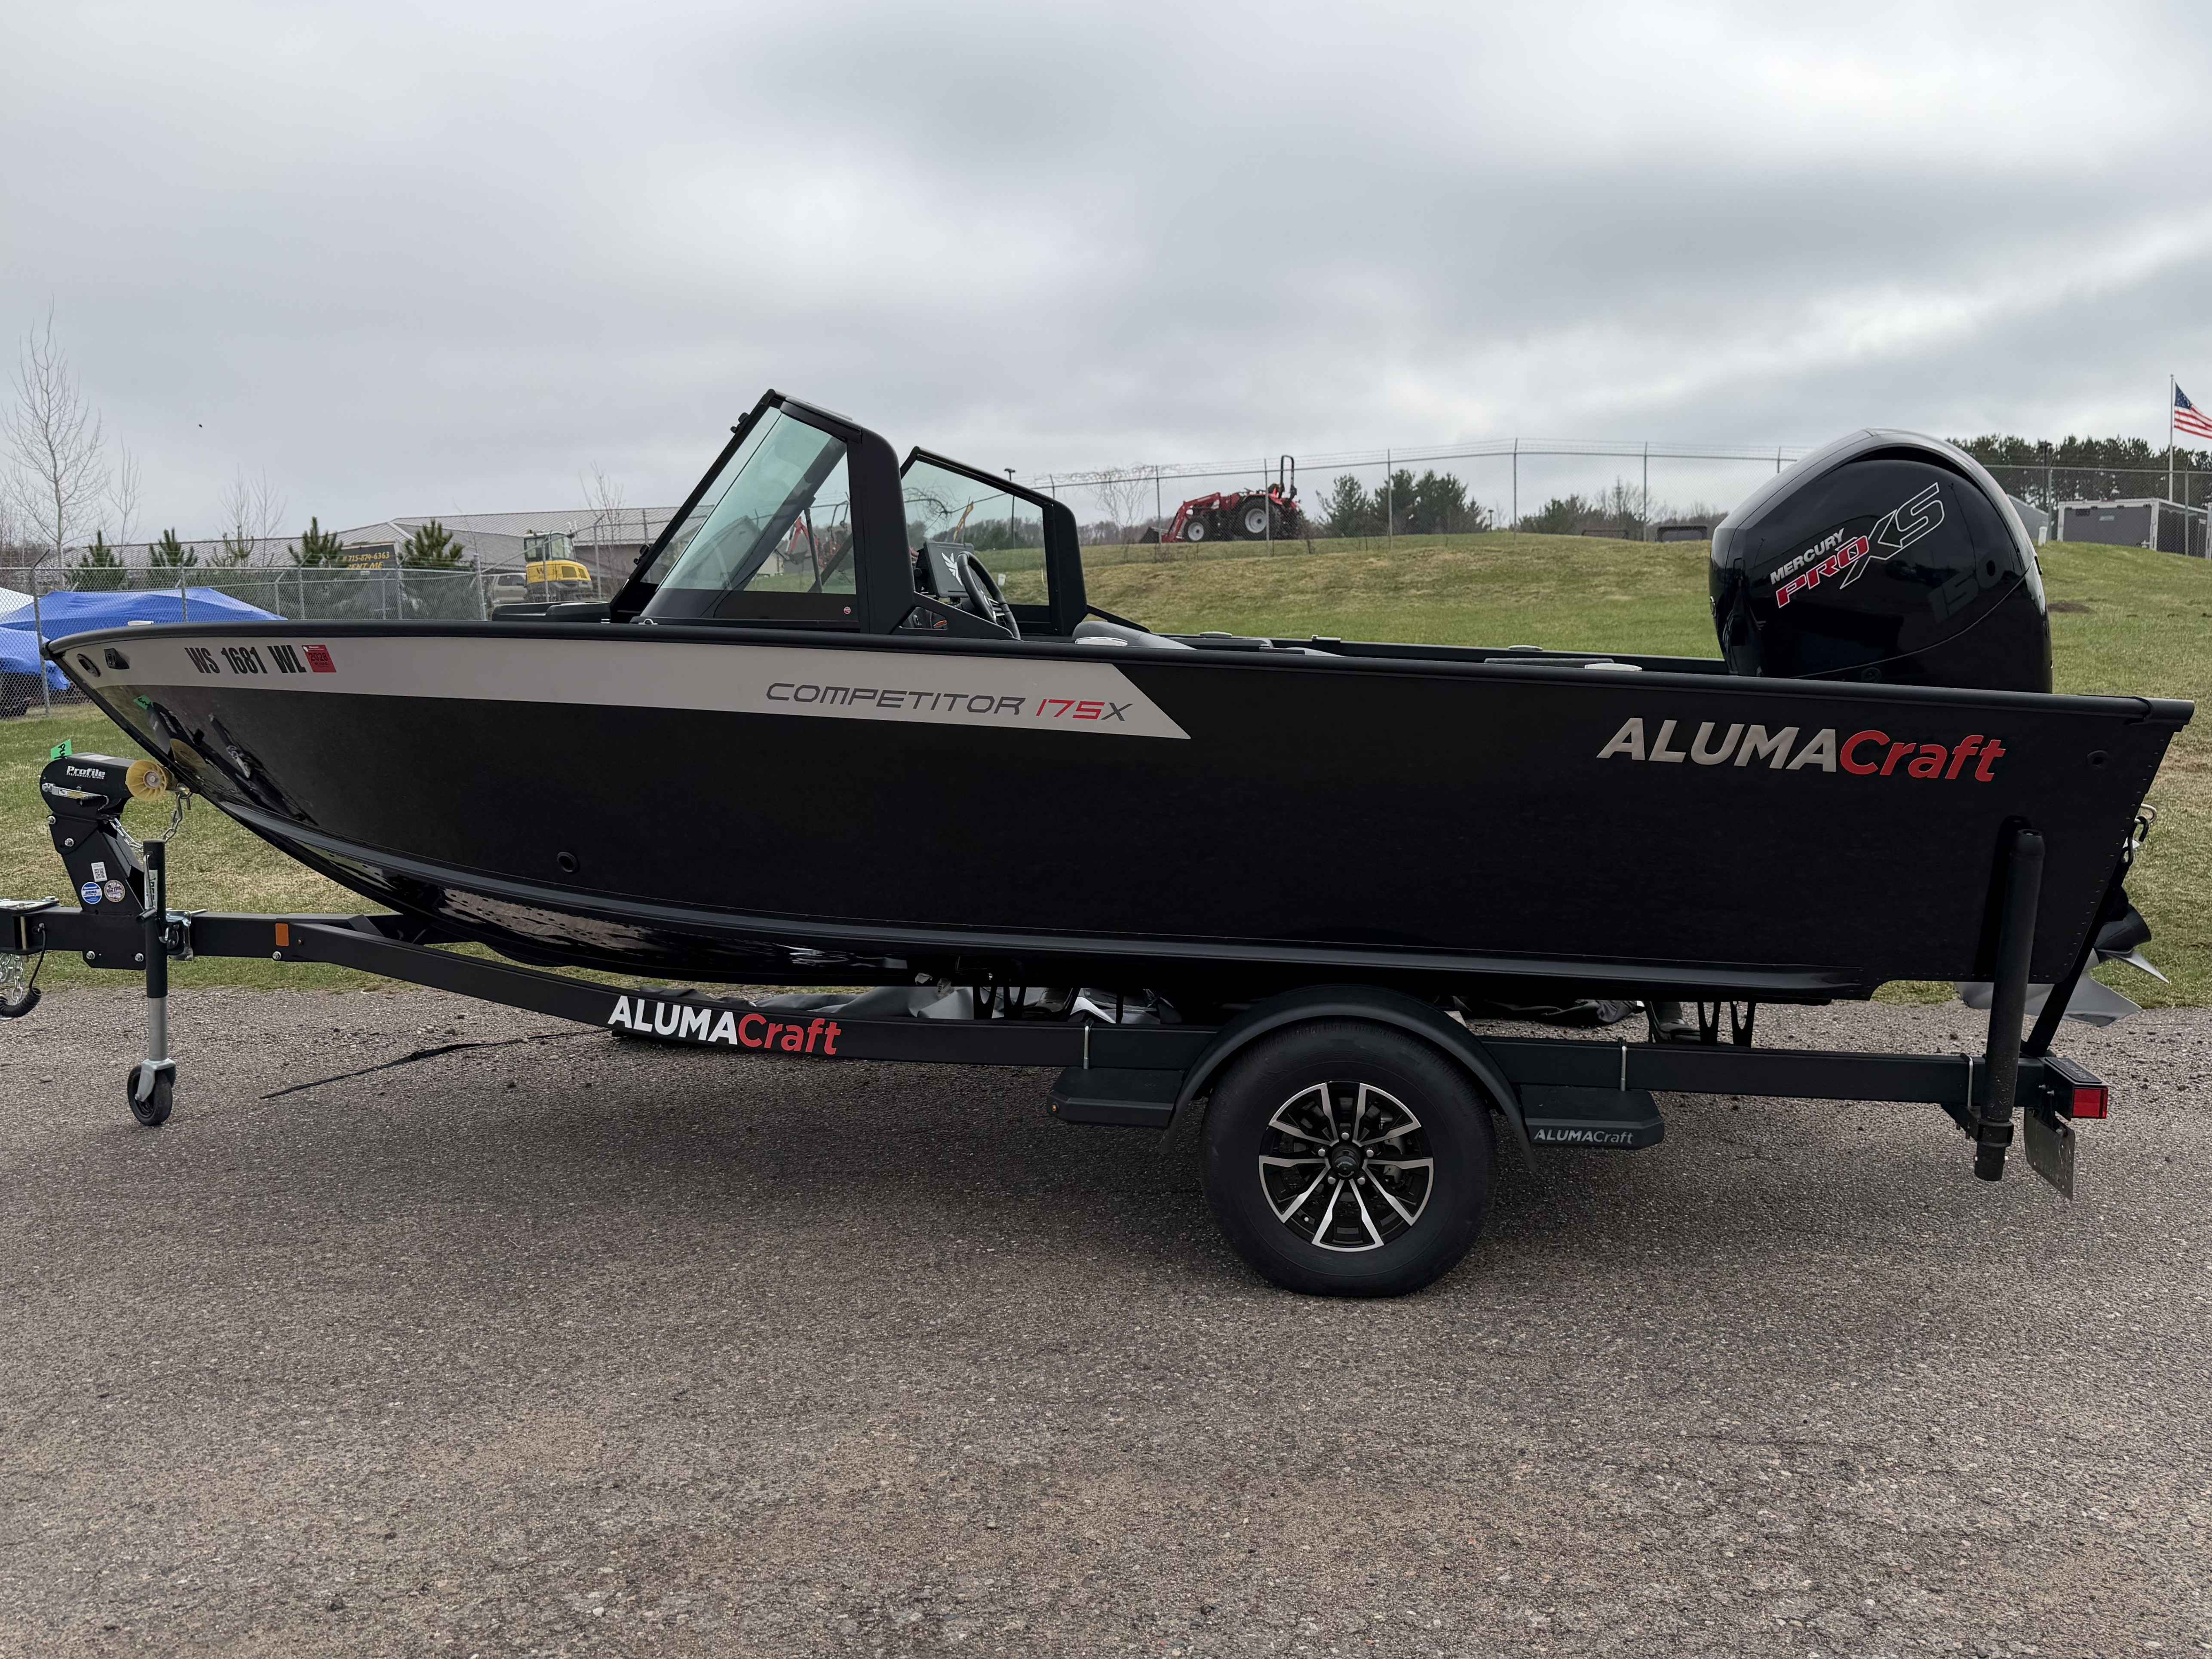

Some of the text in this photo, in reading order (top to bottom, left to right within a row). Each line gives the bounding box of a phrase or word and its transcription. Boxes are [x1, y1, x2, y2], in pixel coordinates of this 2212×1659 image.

[1770, 528, 1844, 584] MERCURY
[184, 645, 307, 674] WS 1681 WL
[767, 683, 1133, 721] COMPETITOR 175X
[1596, 718, 2006, 782] ALUMACraft
[67, 766, 106, 777] Profile
[607, 996, 841, 1055] ALUMACraft
[1534, 1128, 1633, 1144] ALUMACraft
